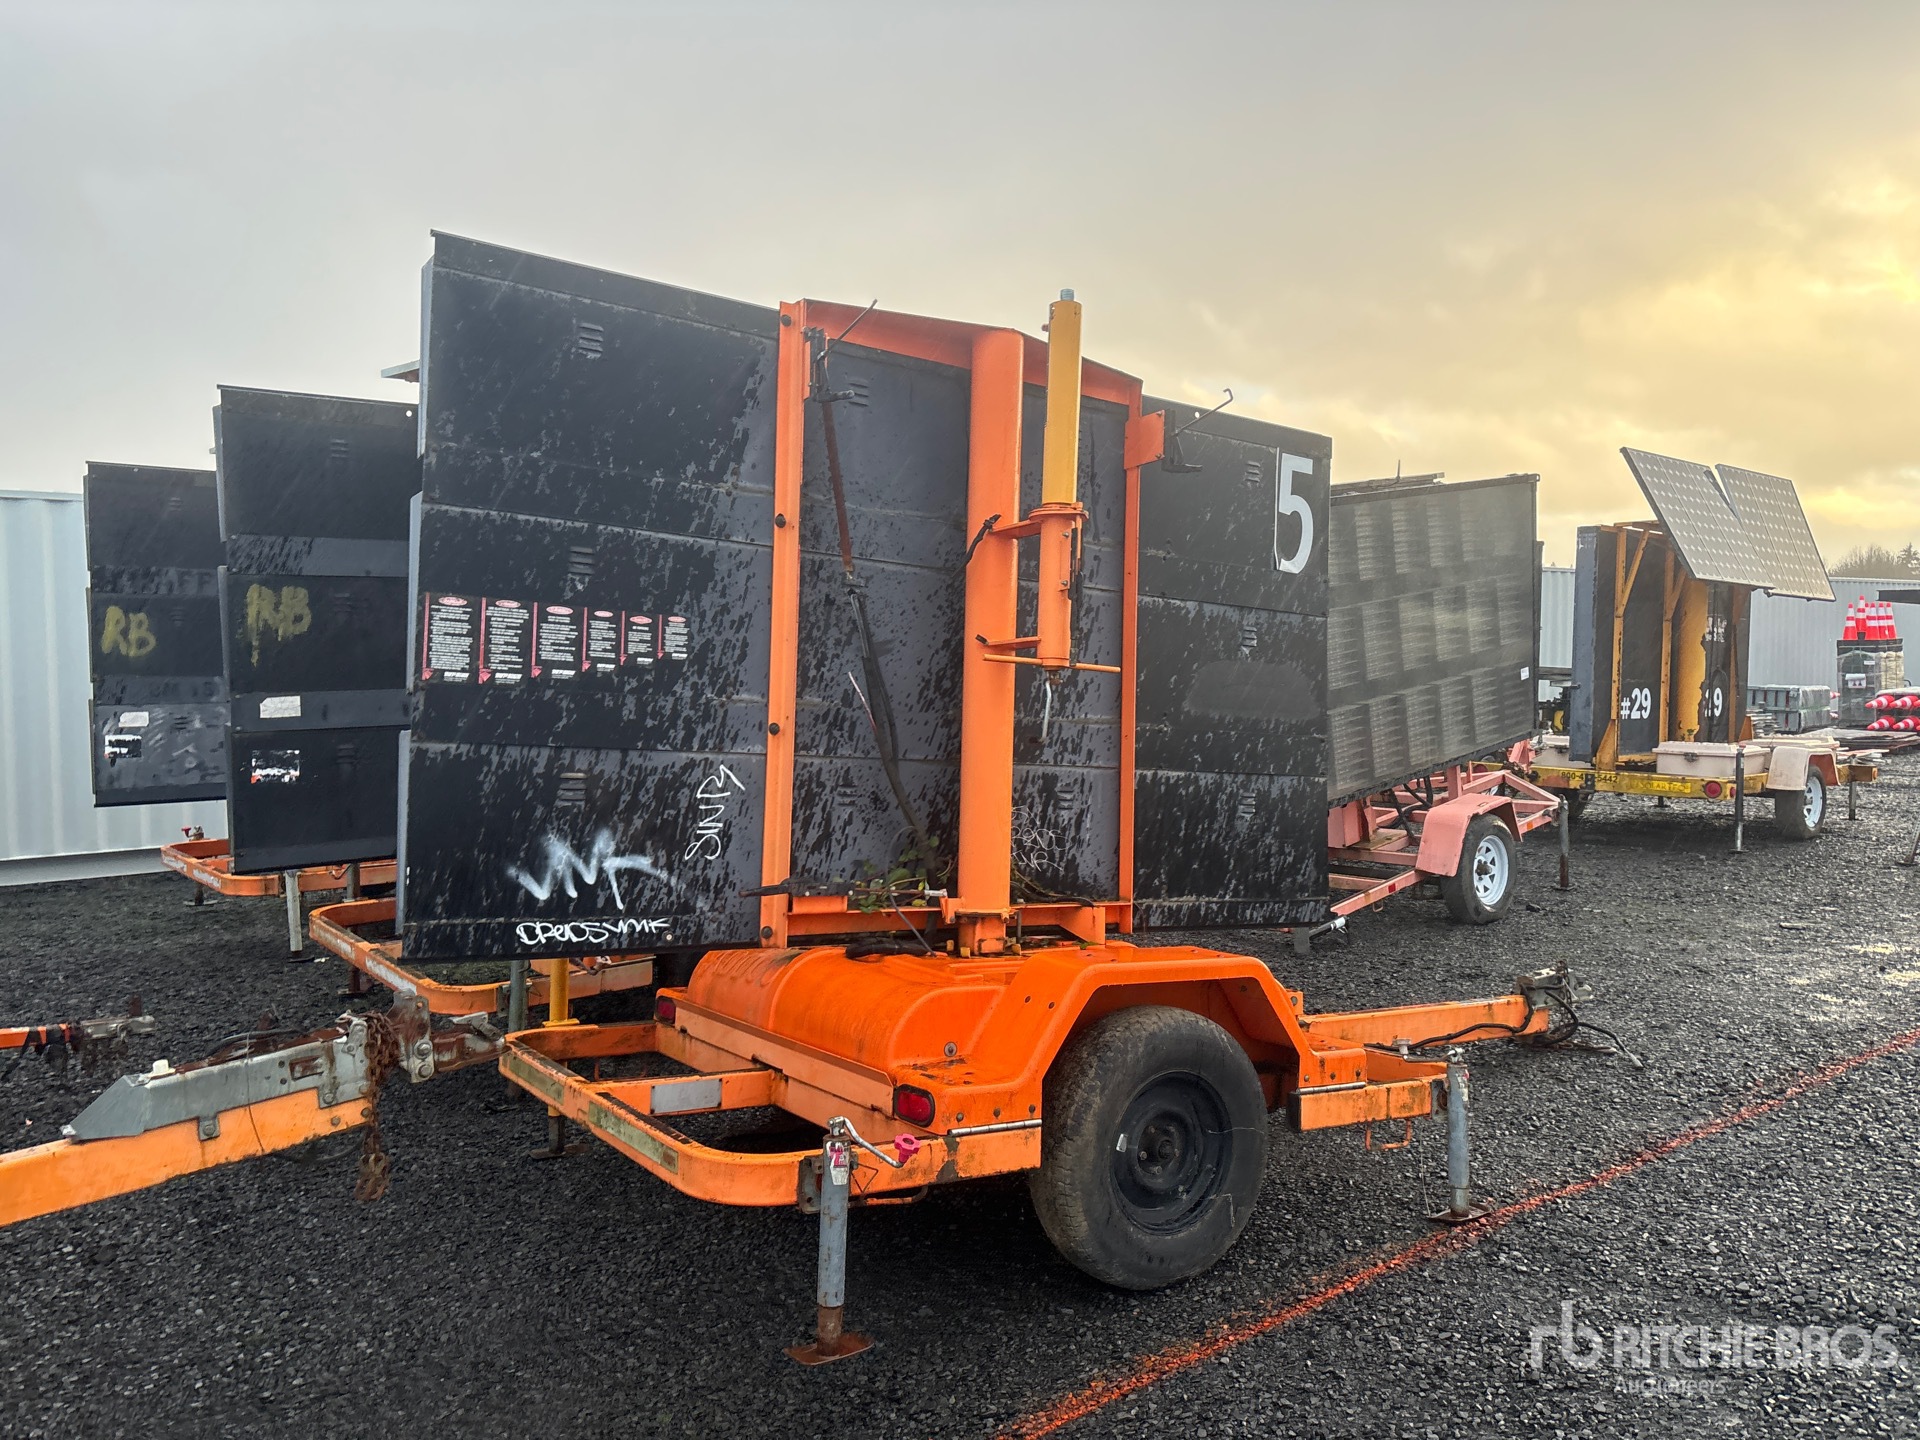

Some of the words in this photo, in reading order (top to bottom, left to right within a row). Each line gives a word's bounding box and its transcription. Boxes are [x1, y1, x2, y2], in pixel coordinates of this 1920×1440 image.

[1277, 453, 1314, 574] 5
[101, 604, 157, 658] RB
[246, 583, 312, 642] RB
[1620, 687, 1651, 720] #29
[1561, 772, 1618, 784] 800-4-5442
